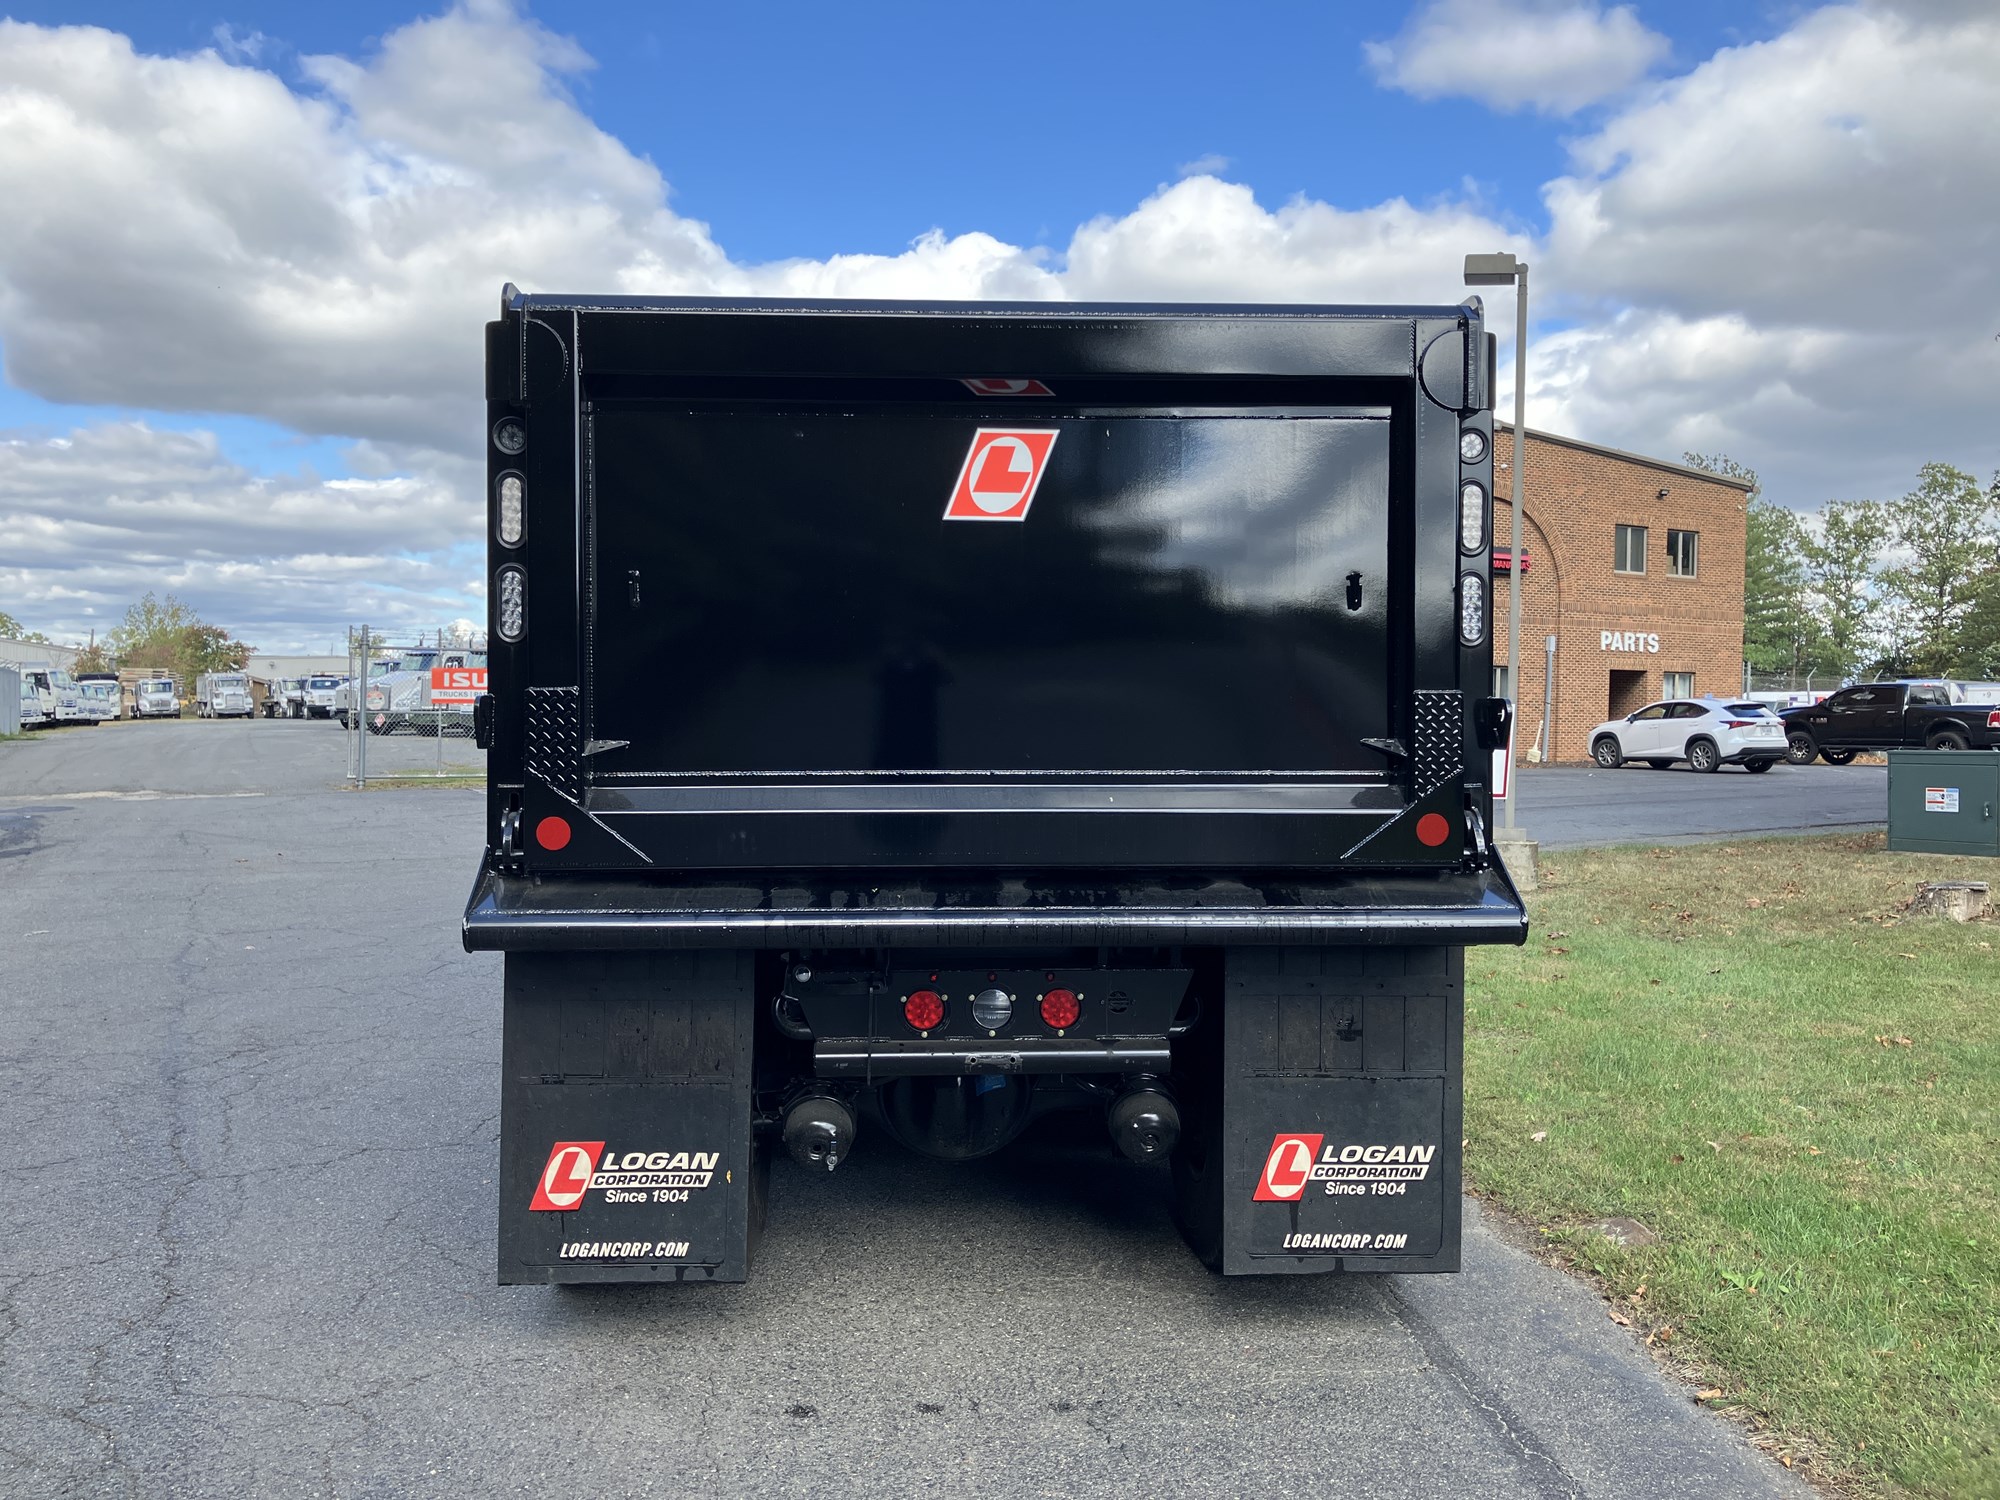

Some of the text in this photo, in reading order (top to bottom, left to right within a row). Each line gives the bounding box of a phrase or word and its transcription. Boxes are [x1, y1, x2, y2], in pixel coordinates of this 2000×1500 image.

[971, 445, 1031, 494] L
[1600, 631, 1659, 653] PARTS
[443, 672, 487, 687] ISU
[601, 1152, 720, 1171] LOGAN
[1321, 1145, 1436, 1163] LOGAN
[593, 1174, 707, 1186] CORPORATION
[1314, 1167, 1423, 1178] CORPORATION
[605, 1189, 689, 1203] Since 1904
[1325, 1181, 1406, 1195] Since 1904
[1282, 1233, 1408, 1249] LOGANCORP.COM
[559, 1242, 690, 1258] LOGANCORP.COM
